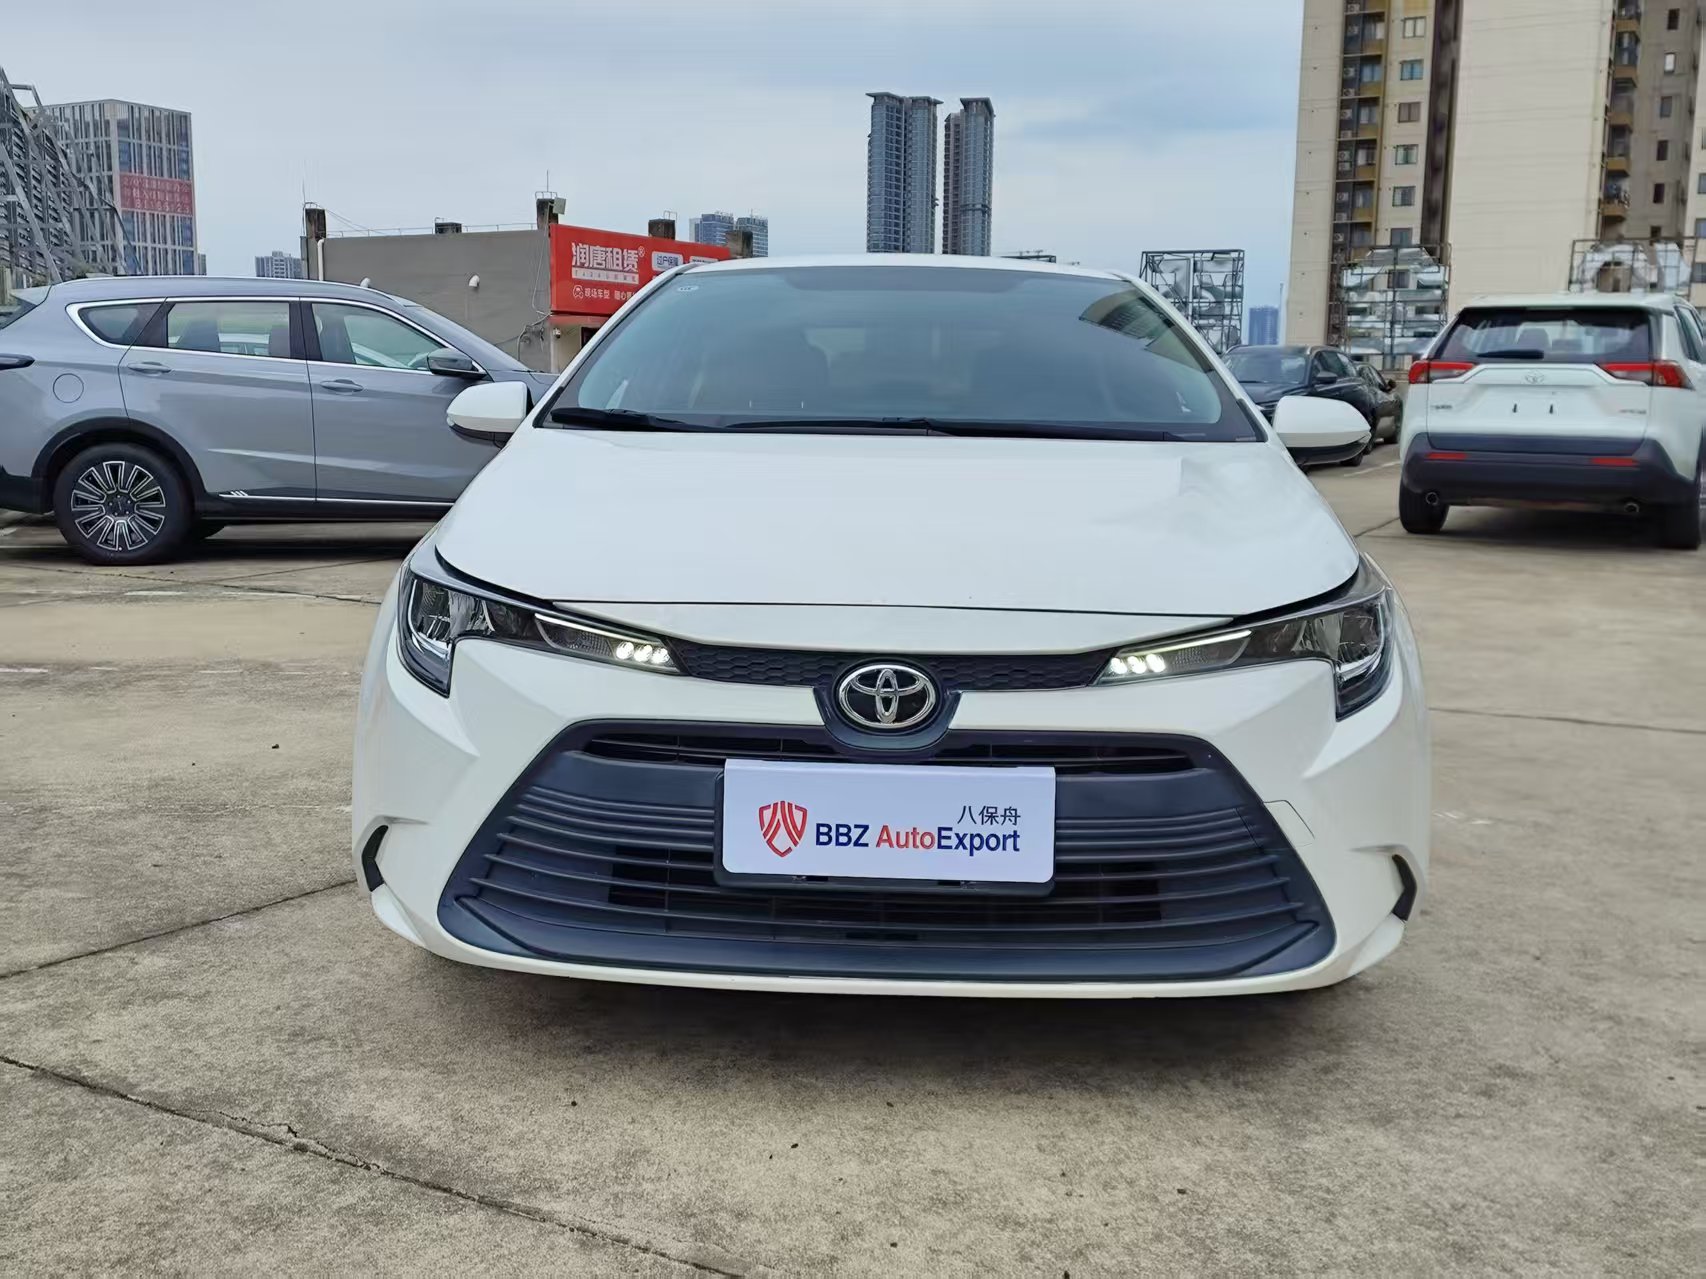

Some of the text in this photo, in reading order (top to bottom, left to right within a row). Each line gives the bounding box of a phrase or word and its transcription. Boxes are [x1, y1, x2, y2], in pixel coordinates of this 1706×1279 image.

[571, 242, 639, 272] 润唐租赁
[957, 805, 1021, 826] 八保舟
[815, 823, 1021, 856] BBZ AutoExport
